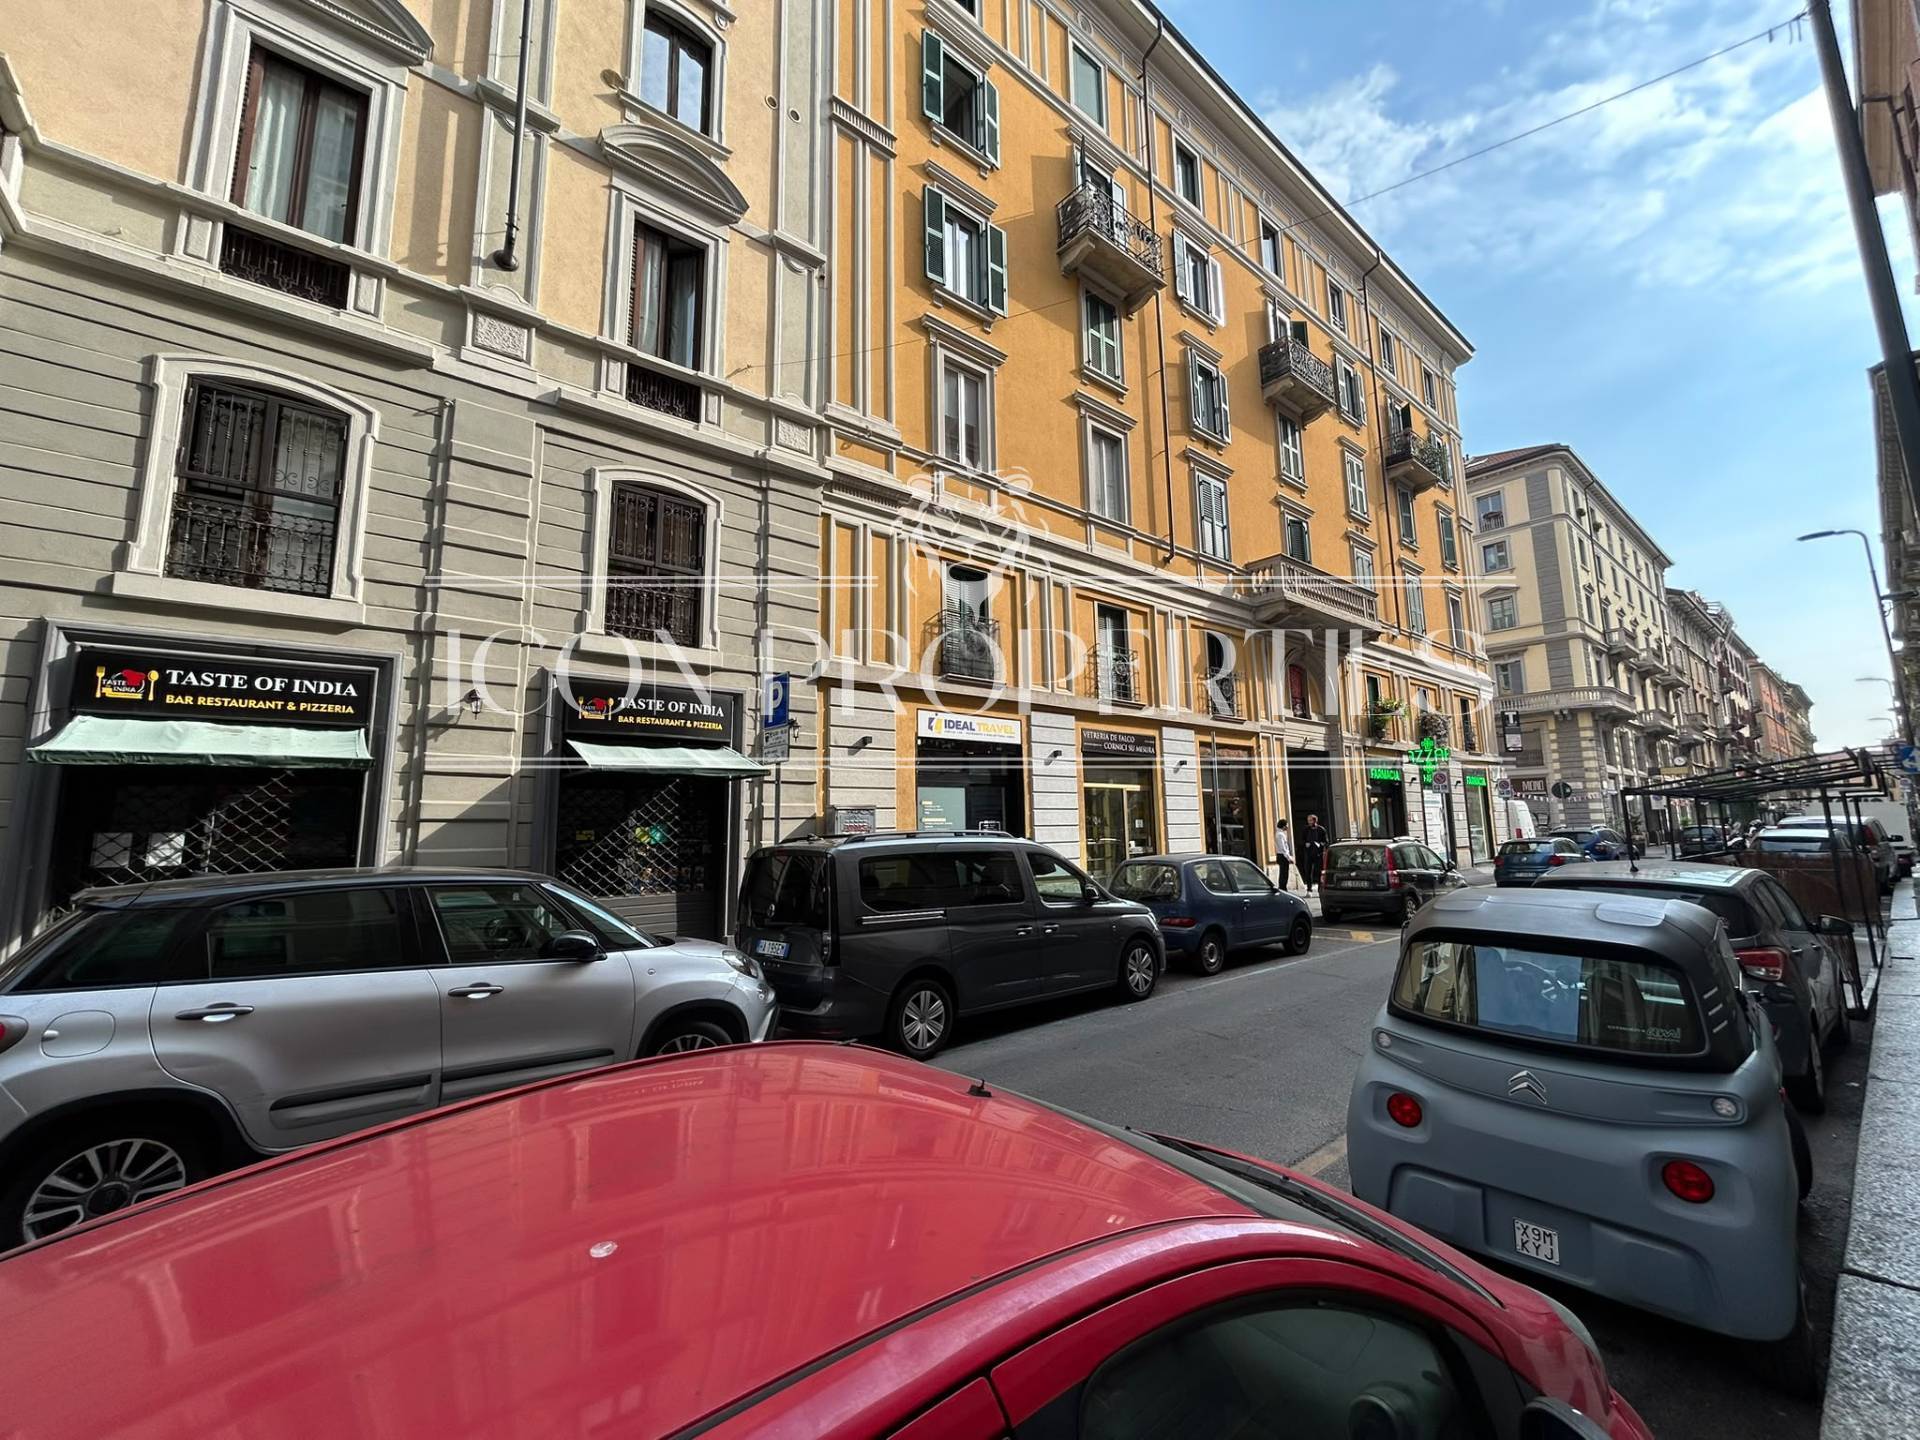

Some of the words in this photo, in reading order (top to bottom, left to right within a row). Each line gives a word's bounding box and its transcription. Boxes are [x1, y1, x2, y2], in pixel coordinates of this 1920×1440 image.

[102, 678, 127, 687] TASTE
[165, 669, 248, 690] TASTE
[254, 676, 288, 692] OF
[292, 679, 358, 697] INDIA
[165, 694, 194, 705] BAR
[197, 696, 284, 710] RESTAURANT
[286, 701, 296, 711] &
[299, 702, 355, 714] PIZZERIA
[618, 697, 665, 711] TASTE
[668, 701, 688, 713] OF
[689, 703, 725, 717] INDIA
[768, 681, 783, 723] P
[636, 717, 685, 727] RESTAURANT
[693, 721, 723, 730] PIZZERIA
[944, 719, 975, 731] IDEAL
[976, 723, 1015, 735] TRAVEL
[1110, 734, 1118, 742] DE
[1370, 768, 1400, 780] FARMACIA
[1520, 1223, 1553, 1246] X9M
[1520, 1238, 1554, 1260] KYJ
